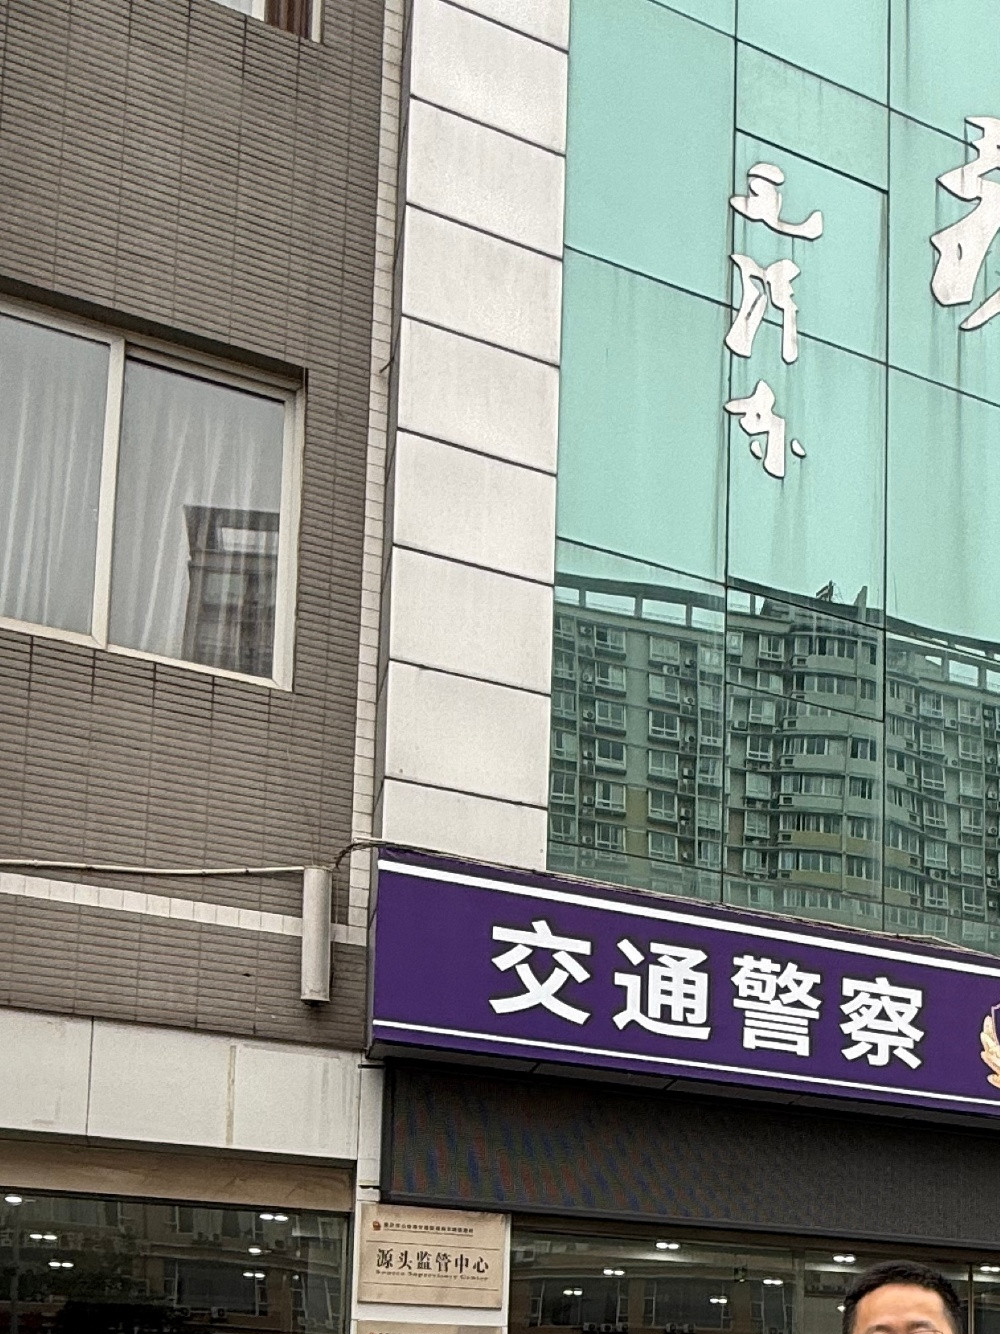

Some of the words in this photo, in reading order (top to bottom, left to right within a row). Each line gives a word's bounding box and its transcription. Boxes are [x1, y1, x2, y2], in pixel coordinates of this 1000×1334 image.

[488, 919, 925, 1070] 交通警察
[376, 1248, 490, 1274] 源头监管中心
